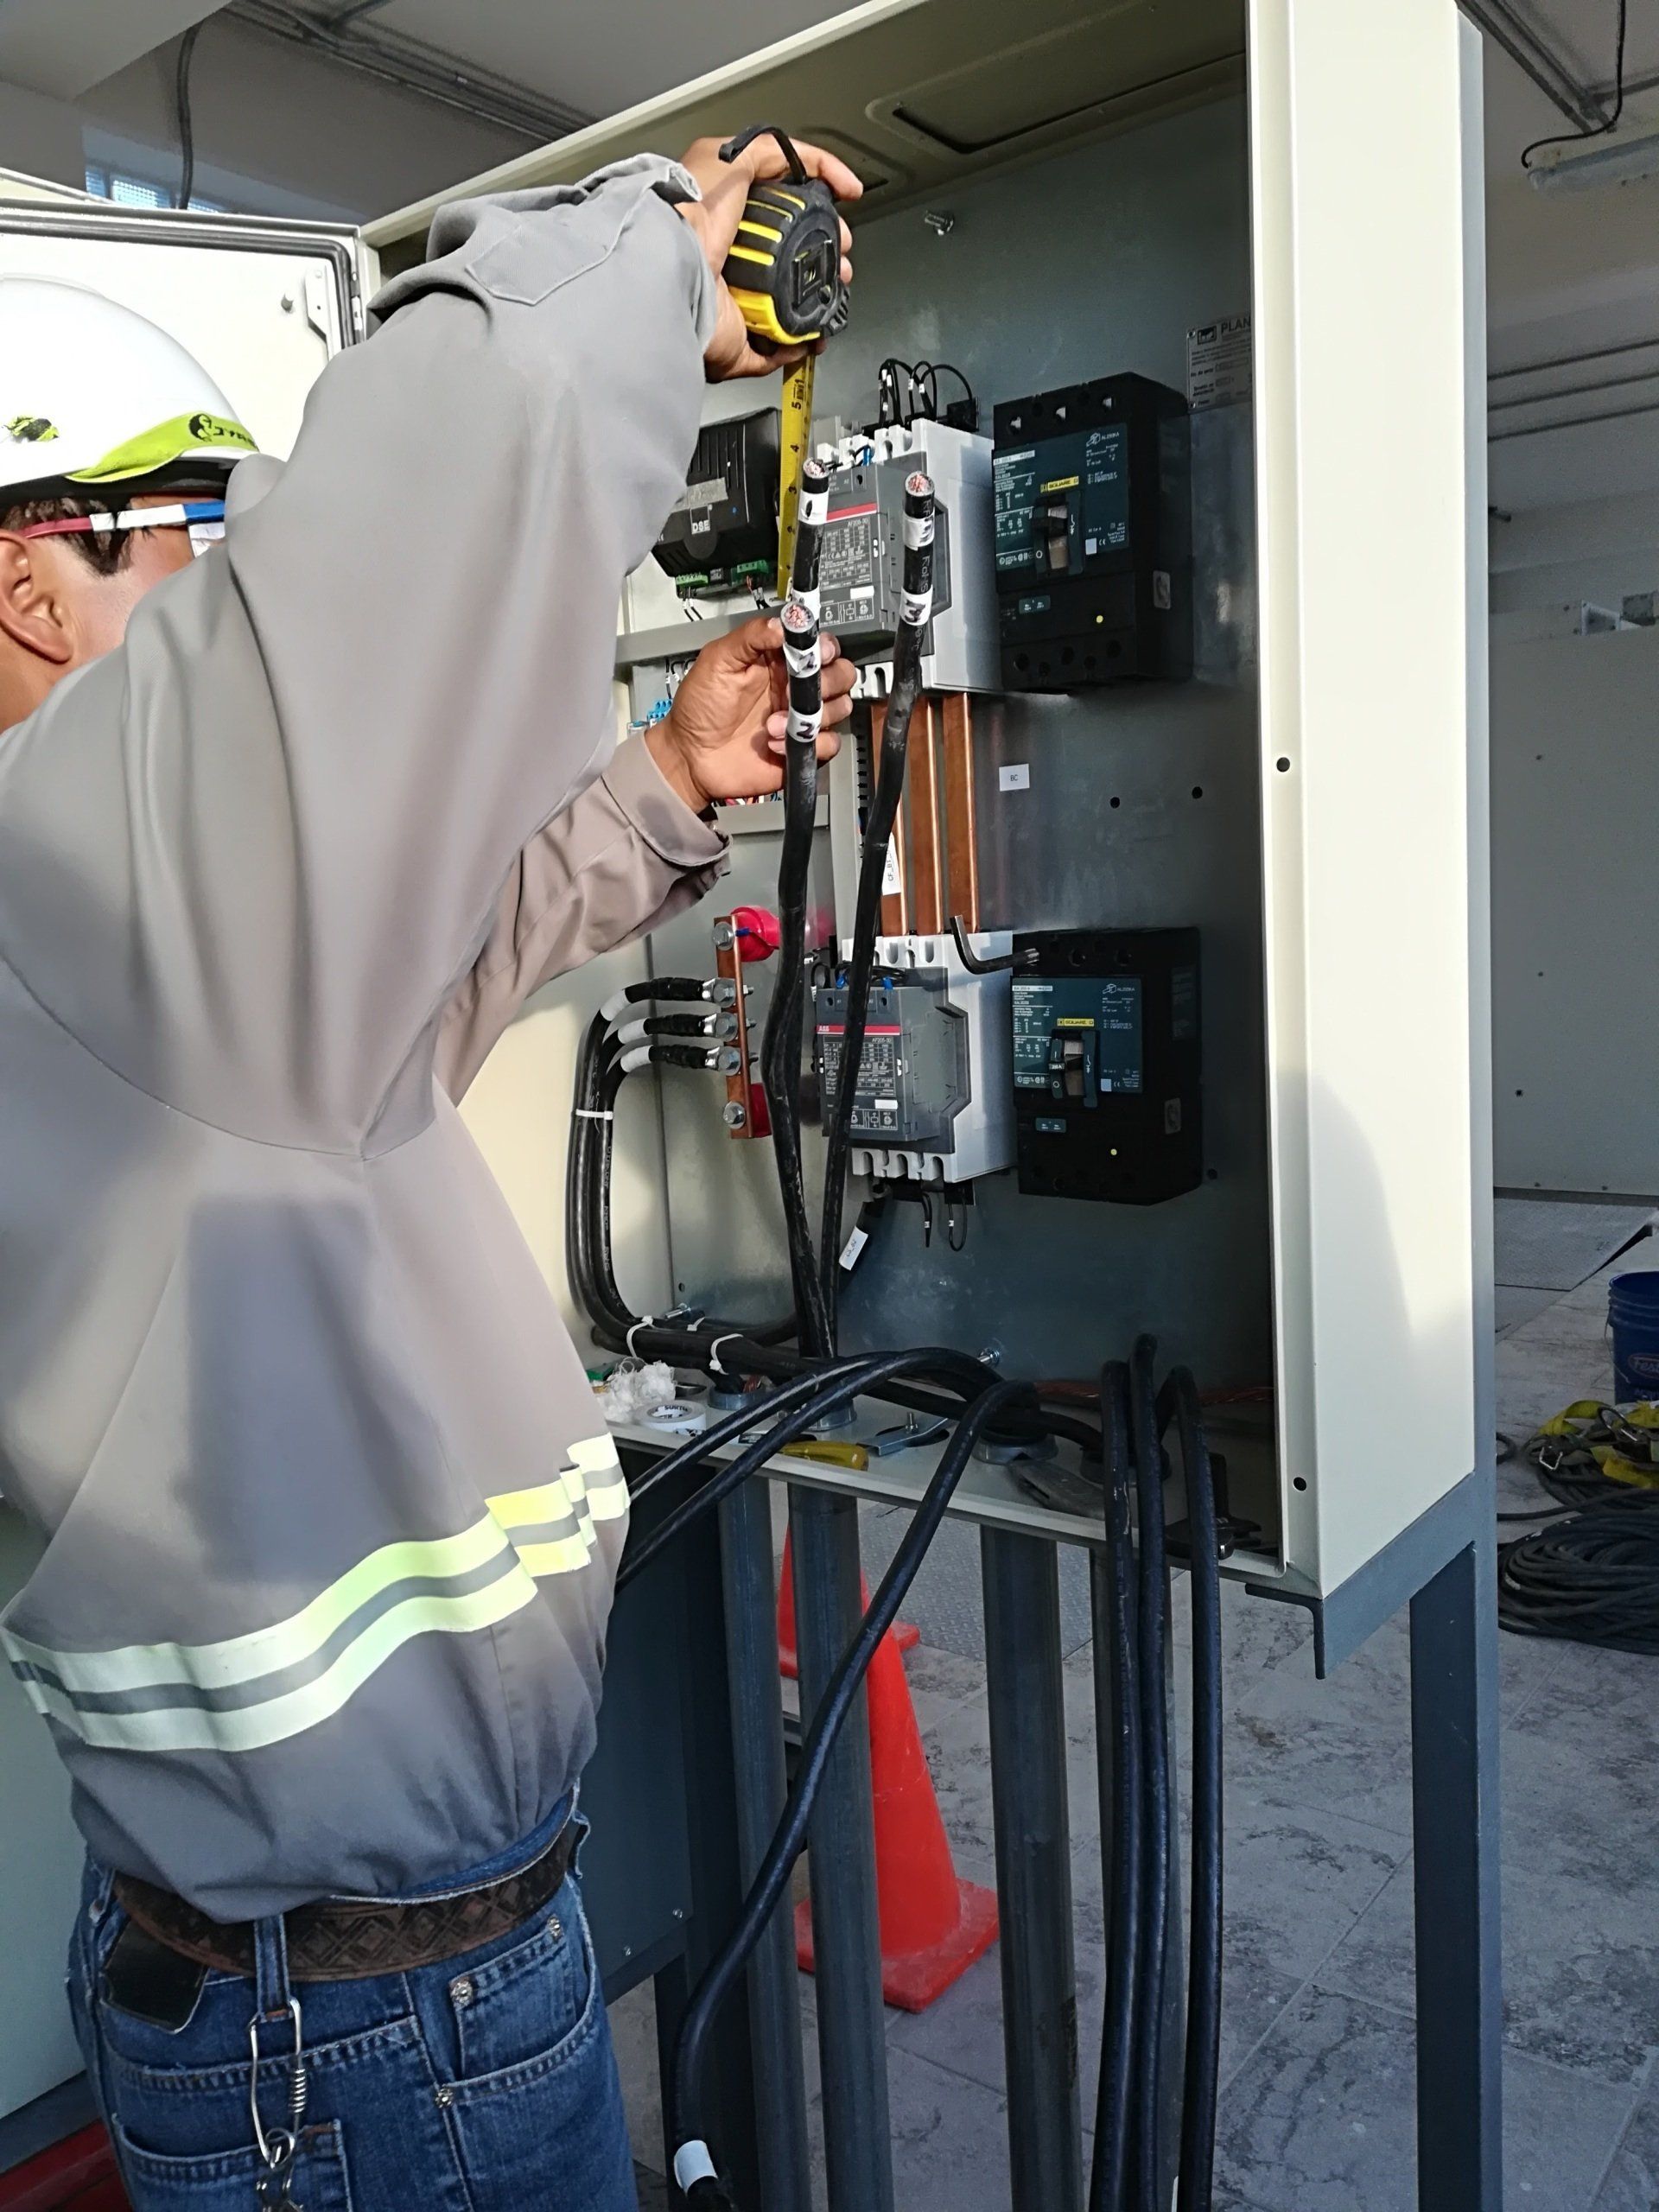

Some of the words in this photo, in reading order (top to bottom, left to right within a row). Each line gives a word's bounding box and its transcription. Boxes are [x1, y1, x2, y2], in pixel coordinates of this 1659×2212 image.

[692, 519, 710, 533] DSE
[920, 555, 931, 594] RoHS
[796, 721, 815, 740] 2
